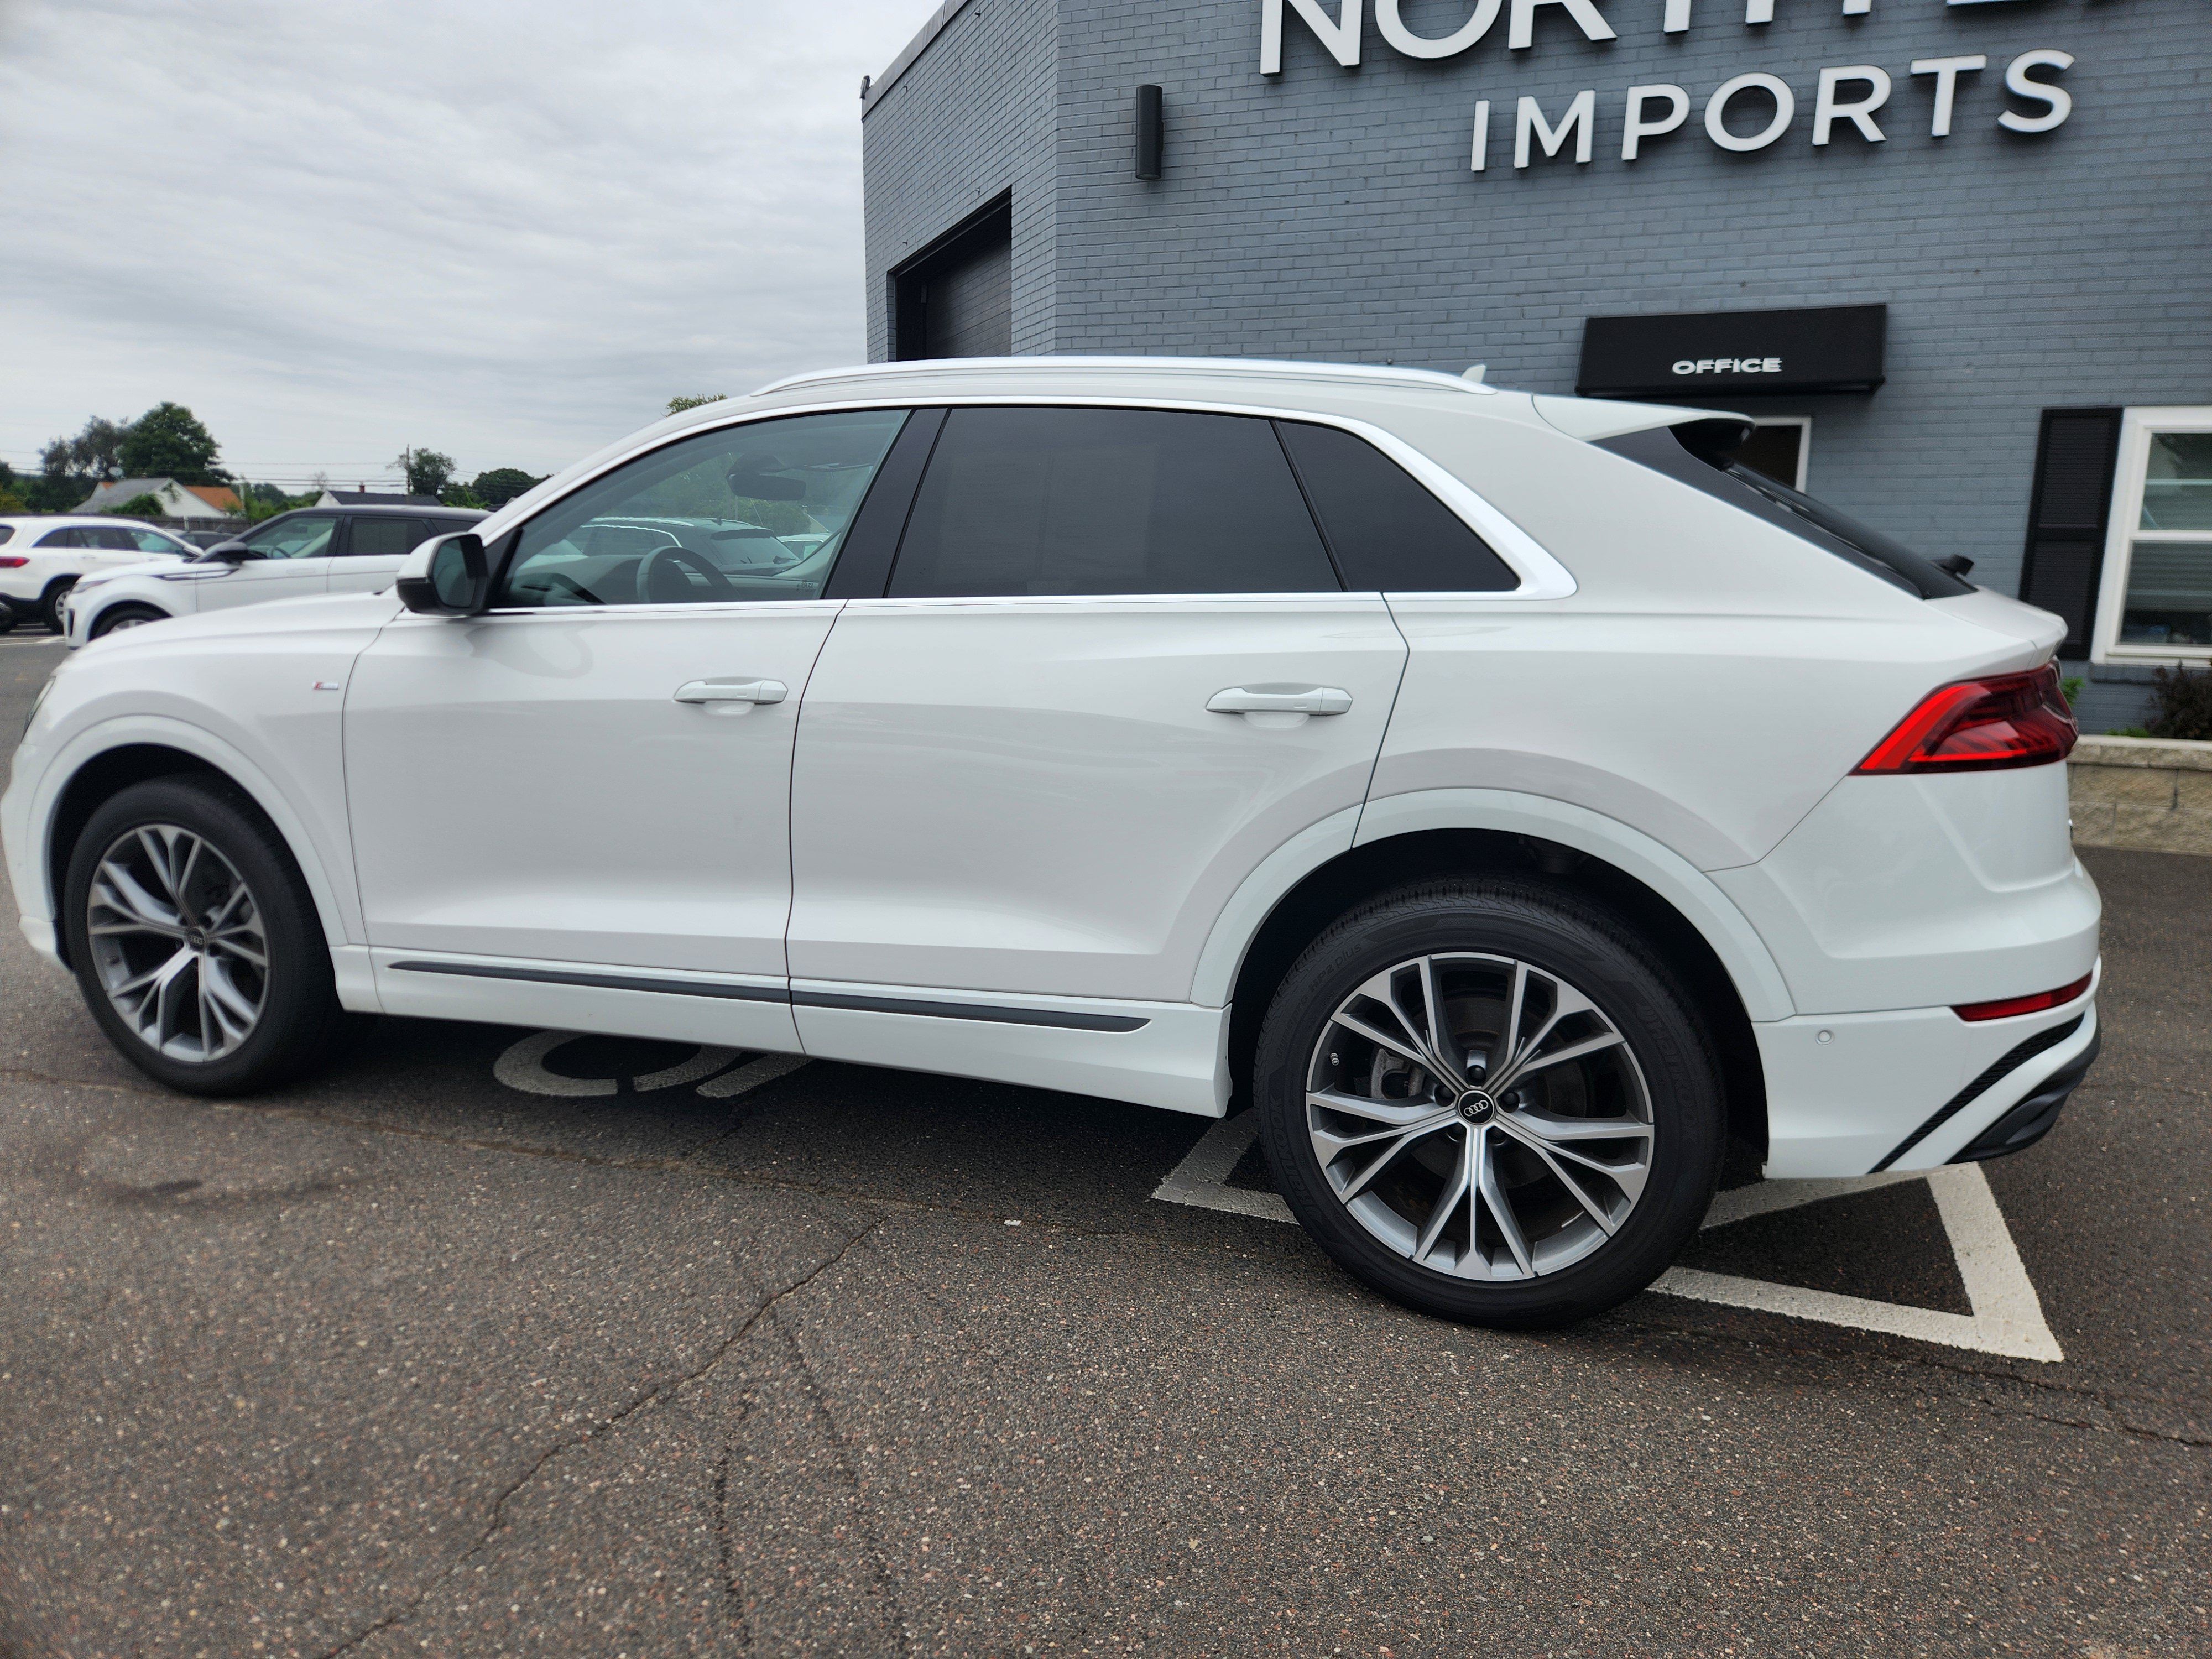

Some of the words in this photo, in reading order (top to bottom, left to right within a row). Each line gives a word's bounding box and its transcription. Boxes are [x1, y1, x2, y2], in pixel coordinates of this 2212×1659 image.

[1470, 49, 2075, 172] IMPORTS
[1672, 358, 1783, 375] OFFICE
[1334, 942, 1363, 969] plus
